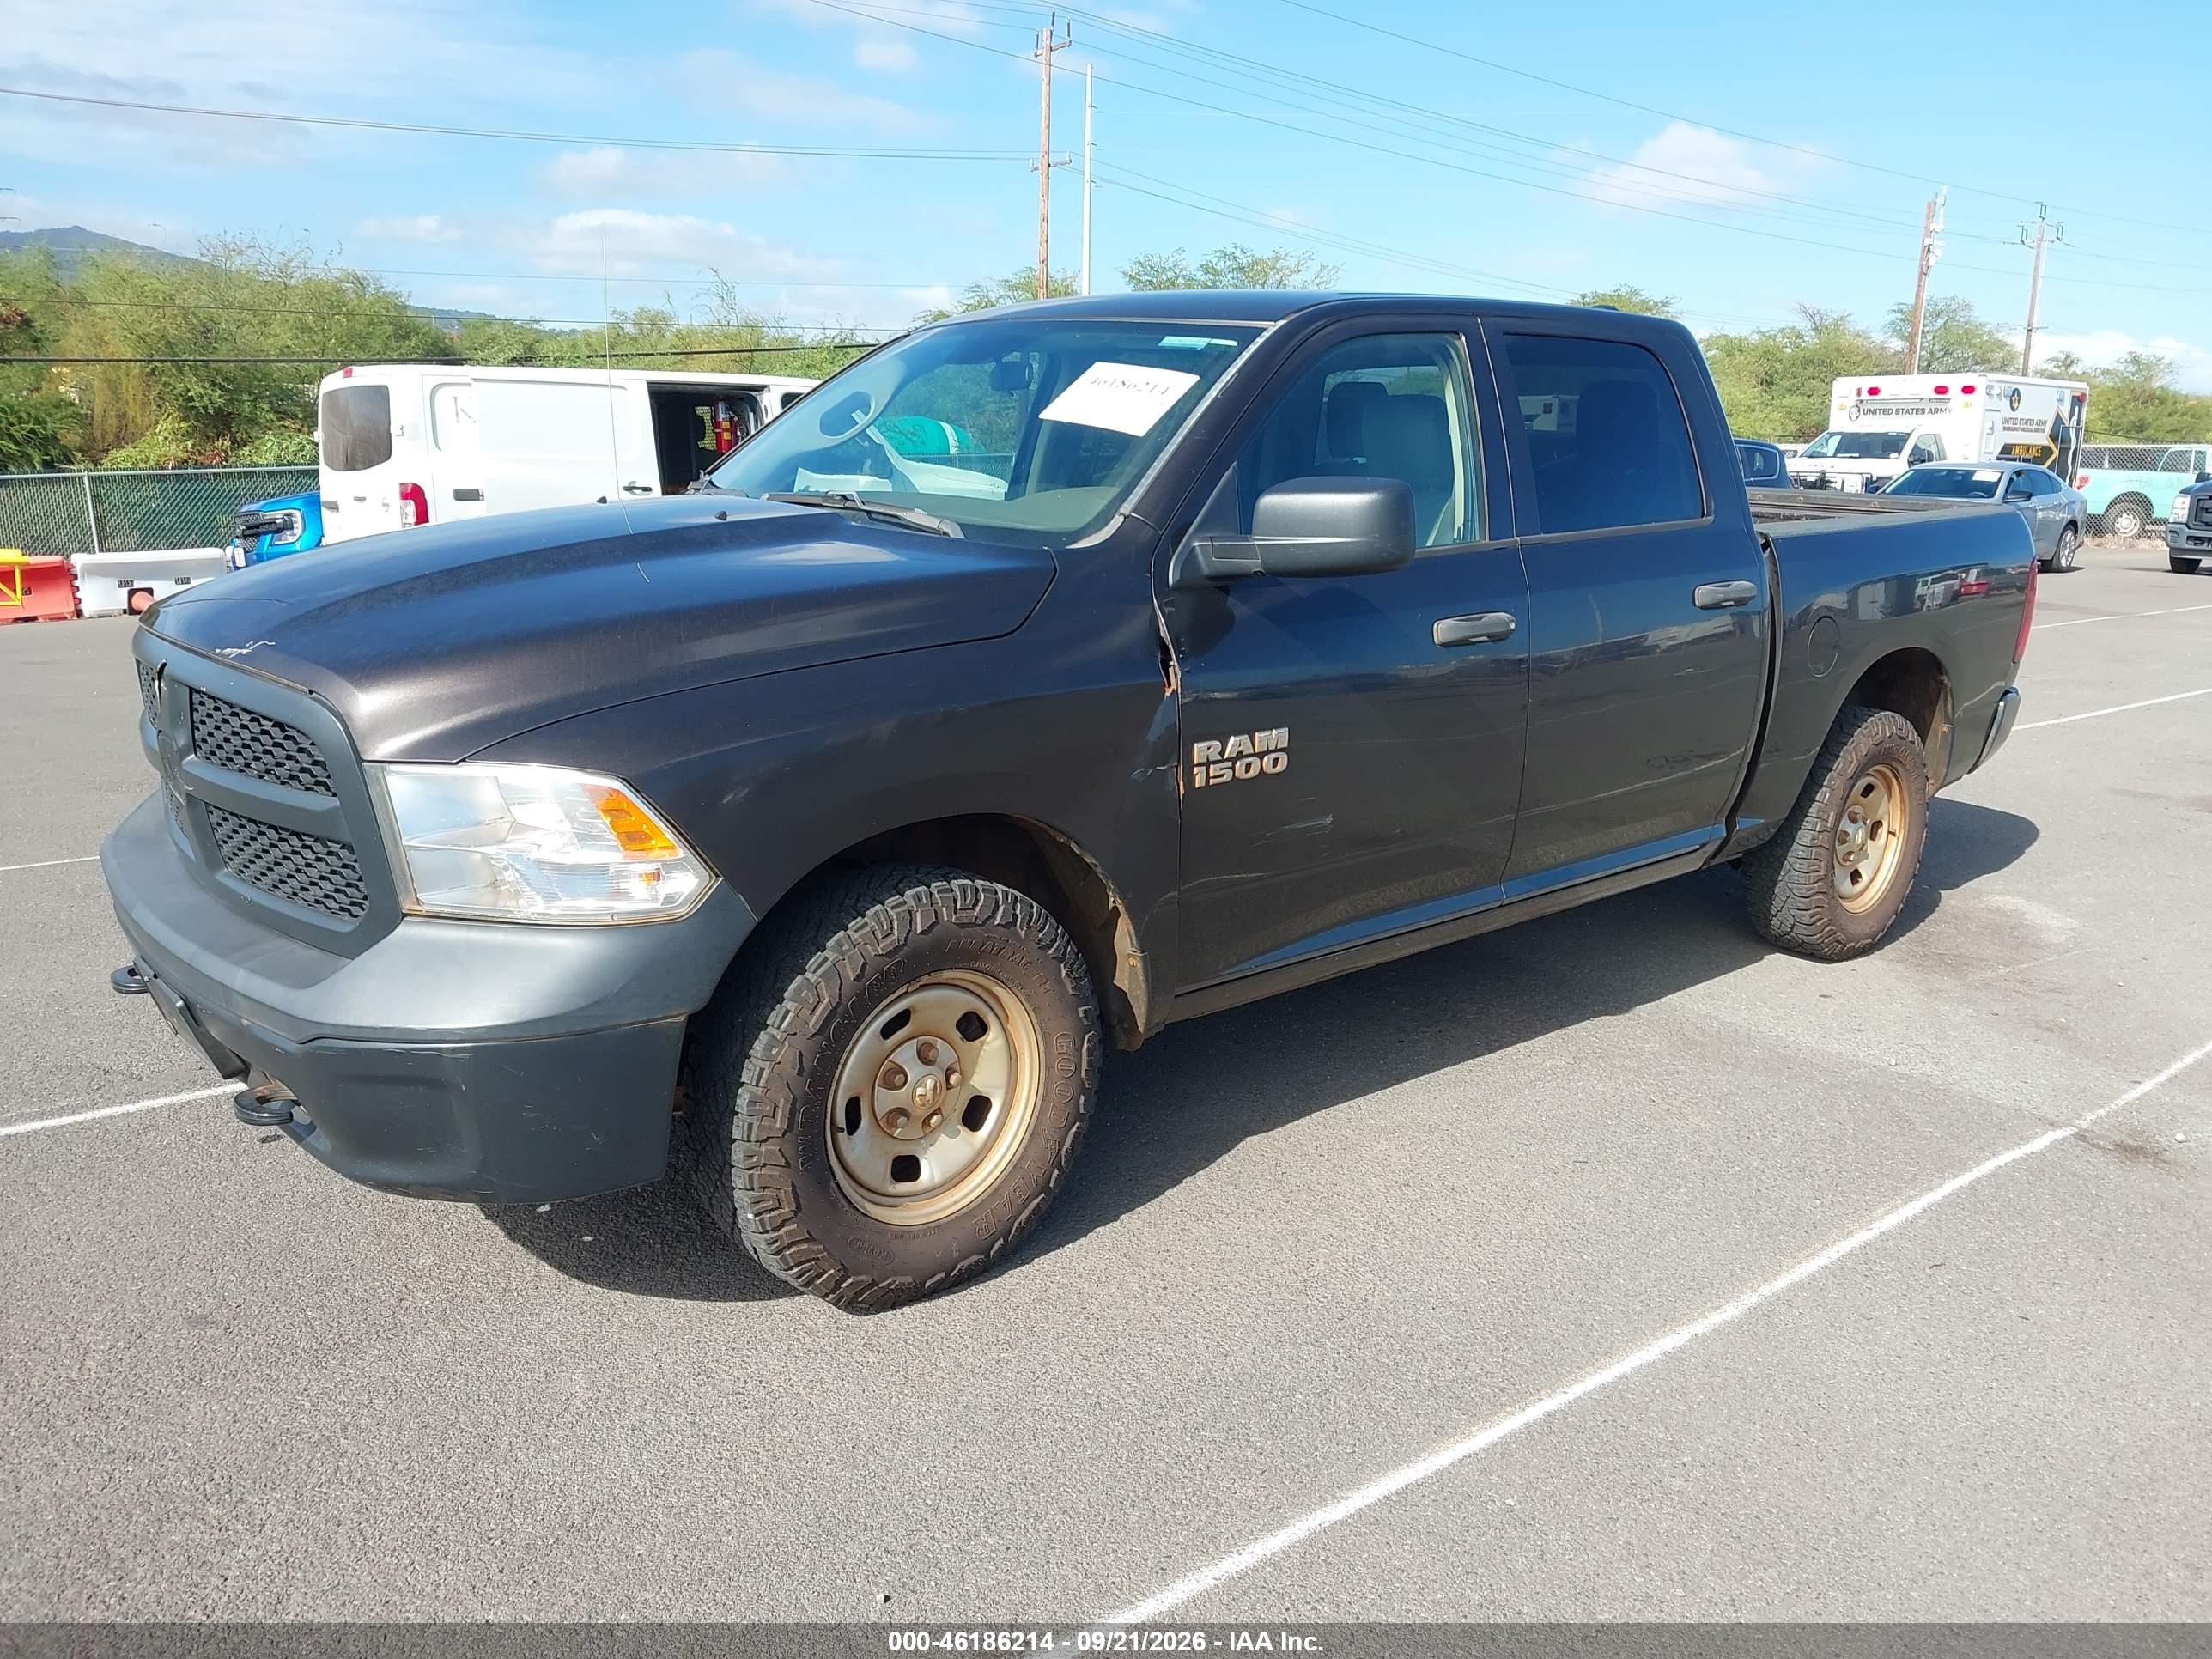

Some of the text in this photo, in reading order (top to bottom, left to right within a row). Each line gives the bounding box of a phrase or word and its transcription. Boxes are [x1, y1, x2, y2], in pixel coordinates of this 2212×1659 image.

[1927, 407, 1952, 416] ARMY
[2002, 416, 2018, 425] UNITED
[2035, 418, 2048, 427] ARMY
[2011, 444, 2042, 456] AMBULANCE
[1194, 727, 1289, 764] RAM
[1194, 751, 1289, 788] 1500
[975, 1031, 1077, 1241] GOODYEAR
